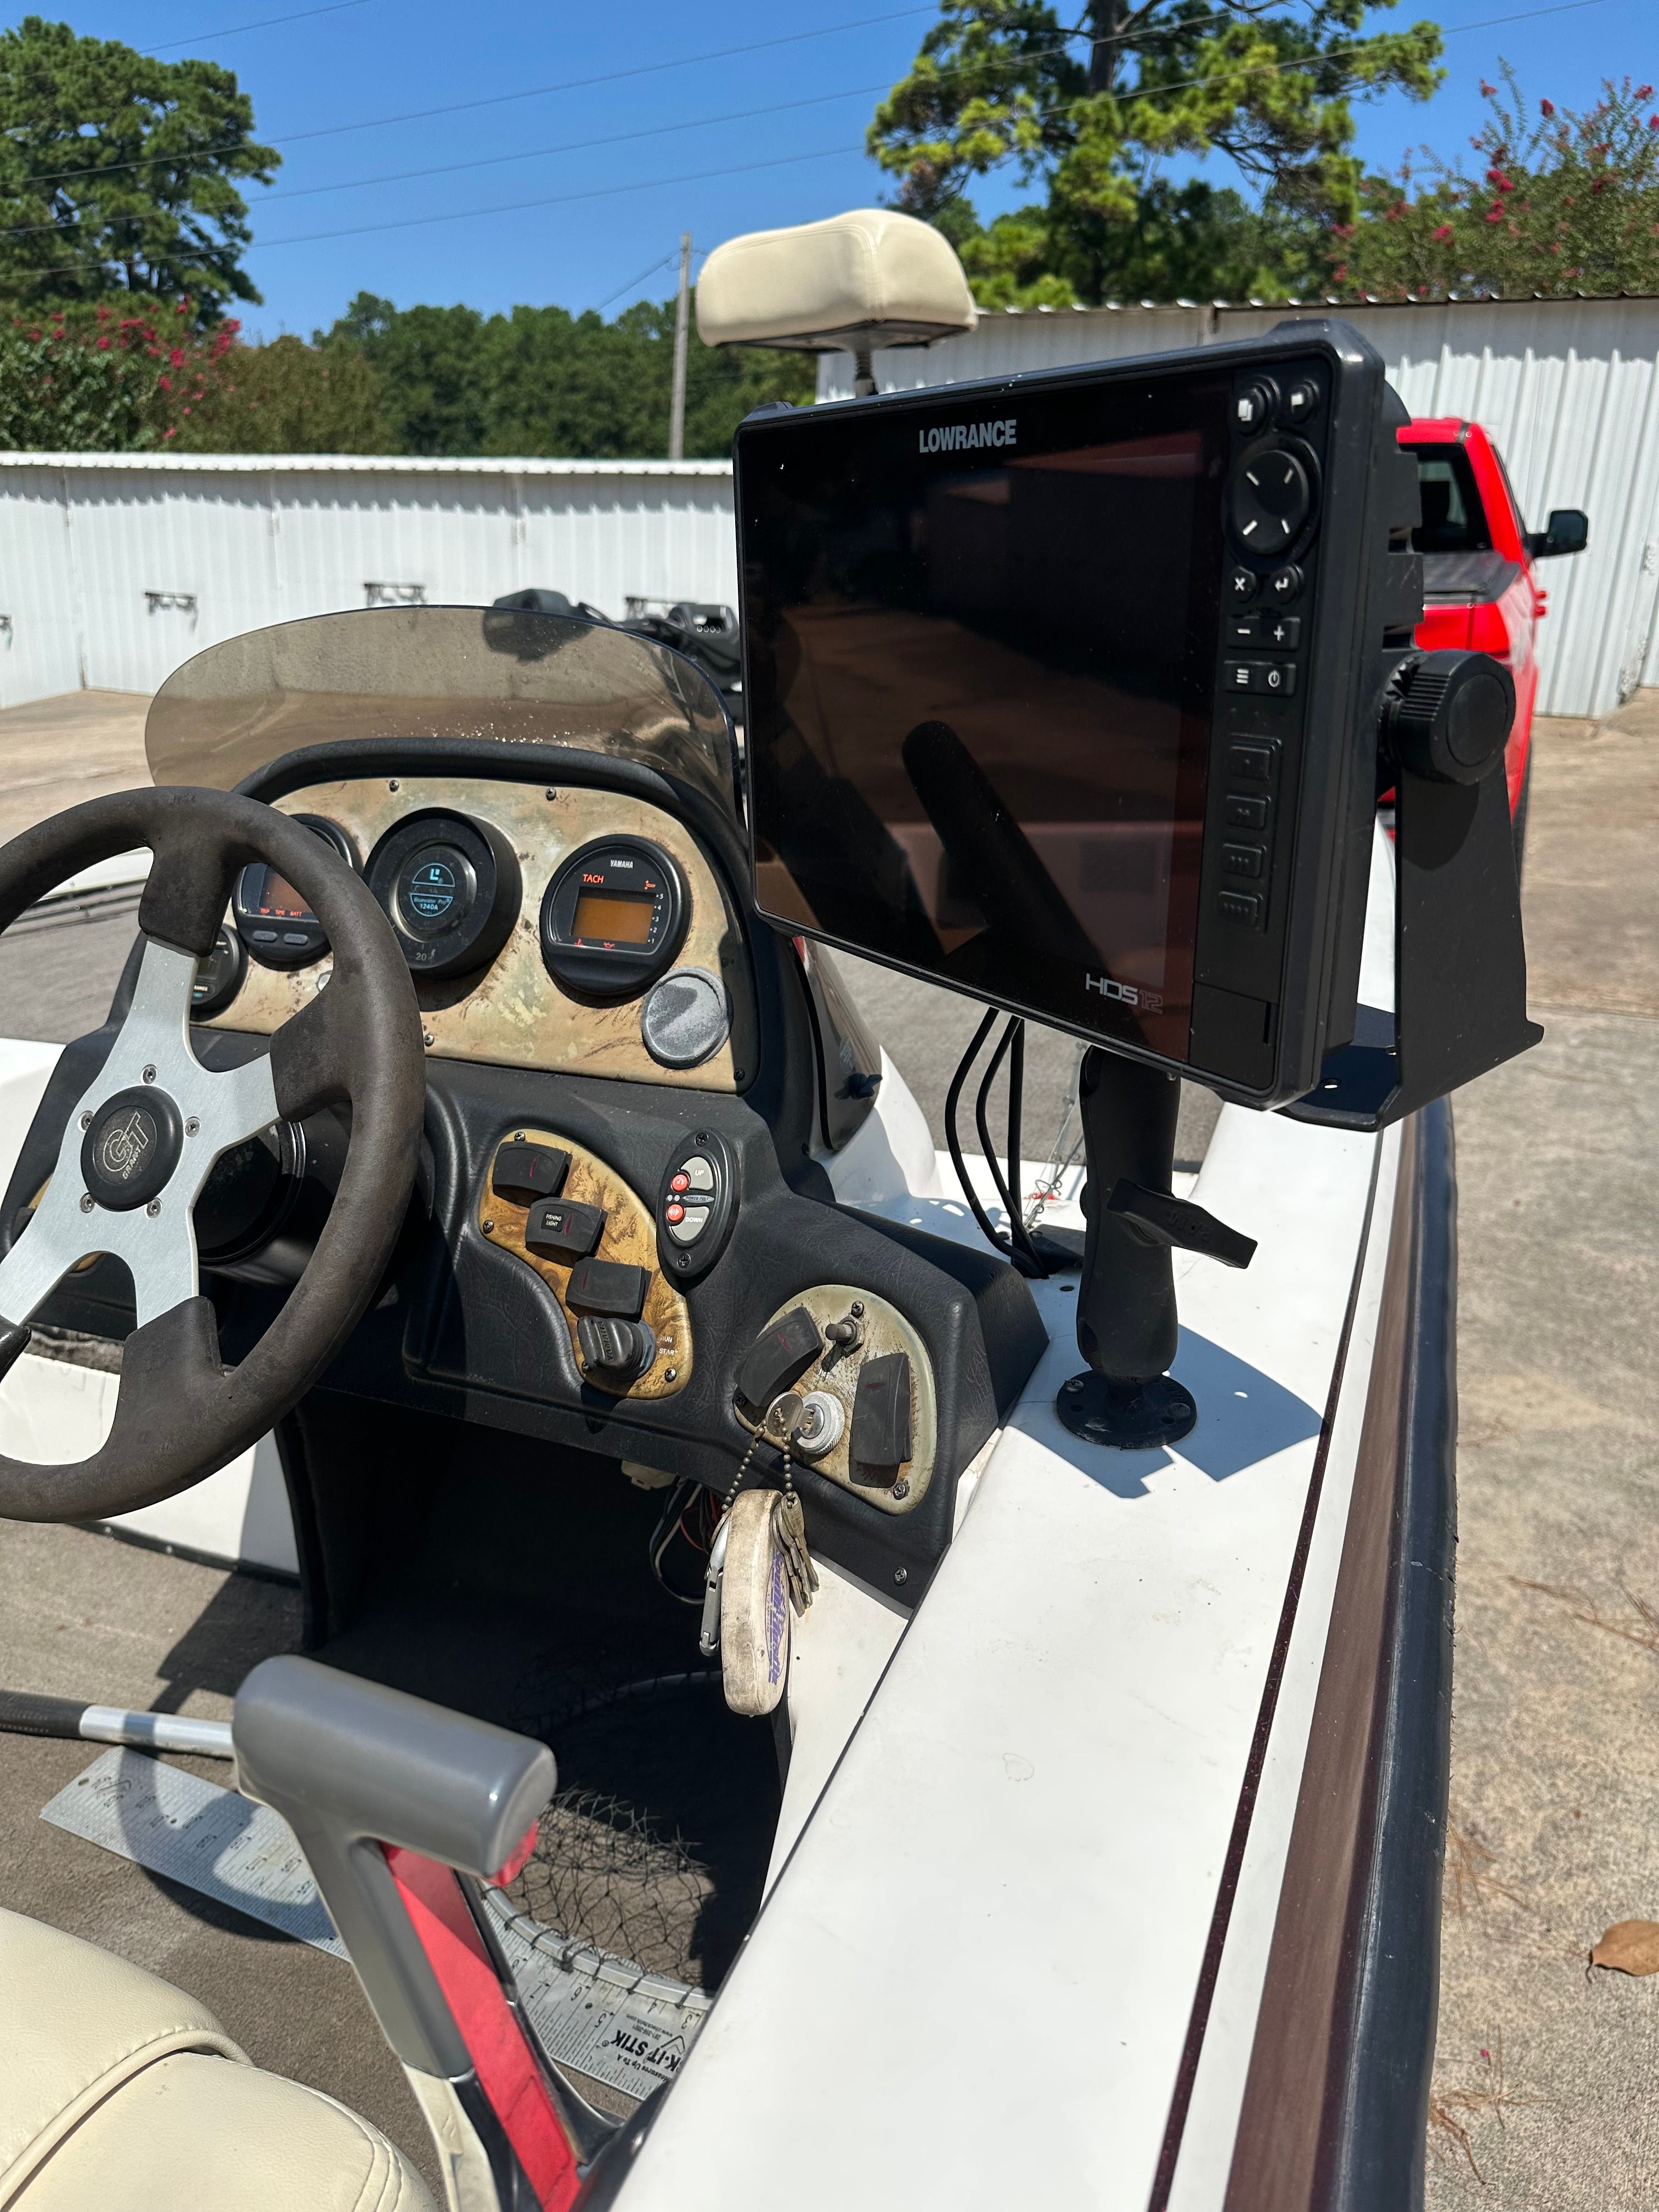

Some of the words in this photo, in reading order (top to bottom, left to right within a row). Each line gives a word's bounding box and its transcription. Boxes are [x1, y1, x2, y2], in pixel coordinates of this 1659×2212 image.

[919, 419, 1017, 453] LOWRANCE
[610, 860, 633, 868] YAMAHA
[583, 873, 604, 883] TACH
[415, 952, 427, 961] 20
[122, 1148, 142, 1180] GRANT
[529, 1984, 542, 1999] 7
[571, 1987, 582, 2001] 6
[647, 2001, 657, 2013] 4
[594, 2013, 607, 2028] 5
[681, 2014, 692, 2029] 3
[611, 2030, 648, 2056] STIK
[623, 2057, 631, 2066] To
[631, 2060, 641, 2070] Up
[647, 2047, 681, 2072] K-IT
